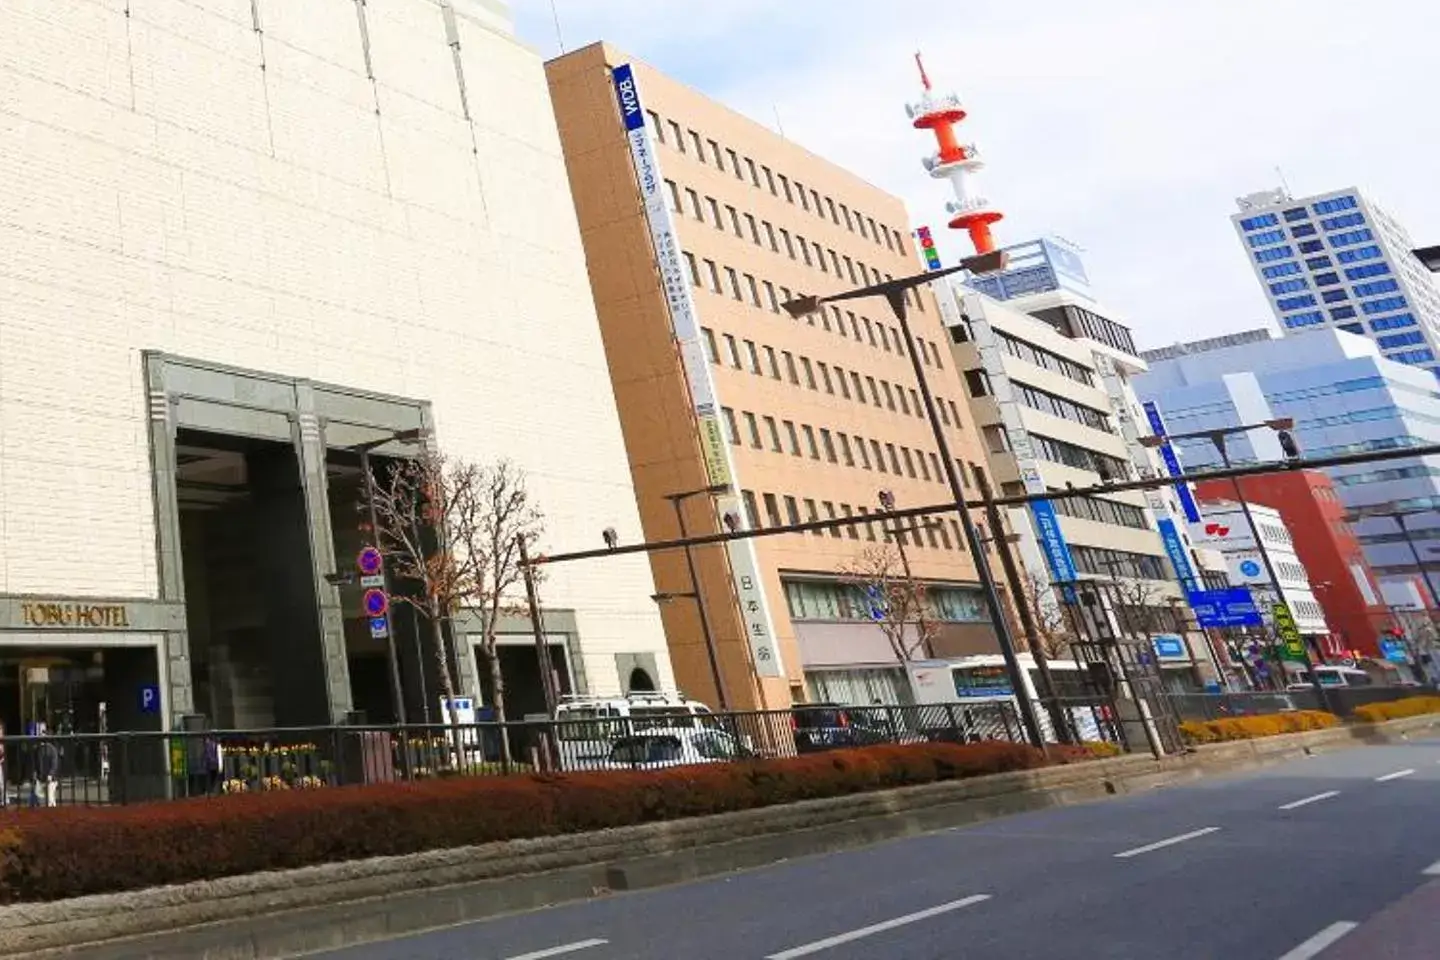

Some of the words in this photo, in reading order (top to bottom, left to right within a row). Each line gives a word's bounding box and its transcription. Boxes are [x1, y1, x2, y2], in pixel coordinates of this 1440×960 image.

[21, 603, 73, 627] TOBU
[76, 604, 130, 627] HOTEL
[740, 575, 771, 662] 日本生命
[143, 689, 153, 709] P
